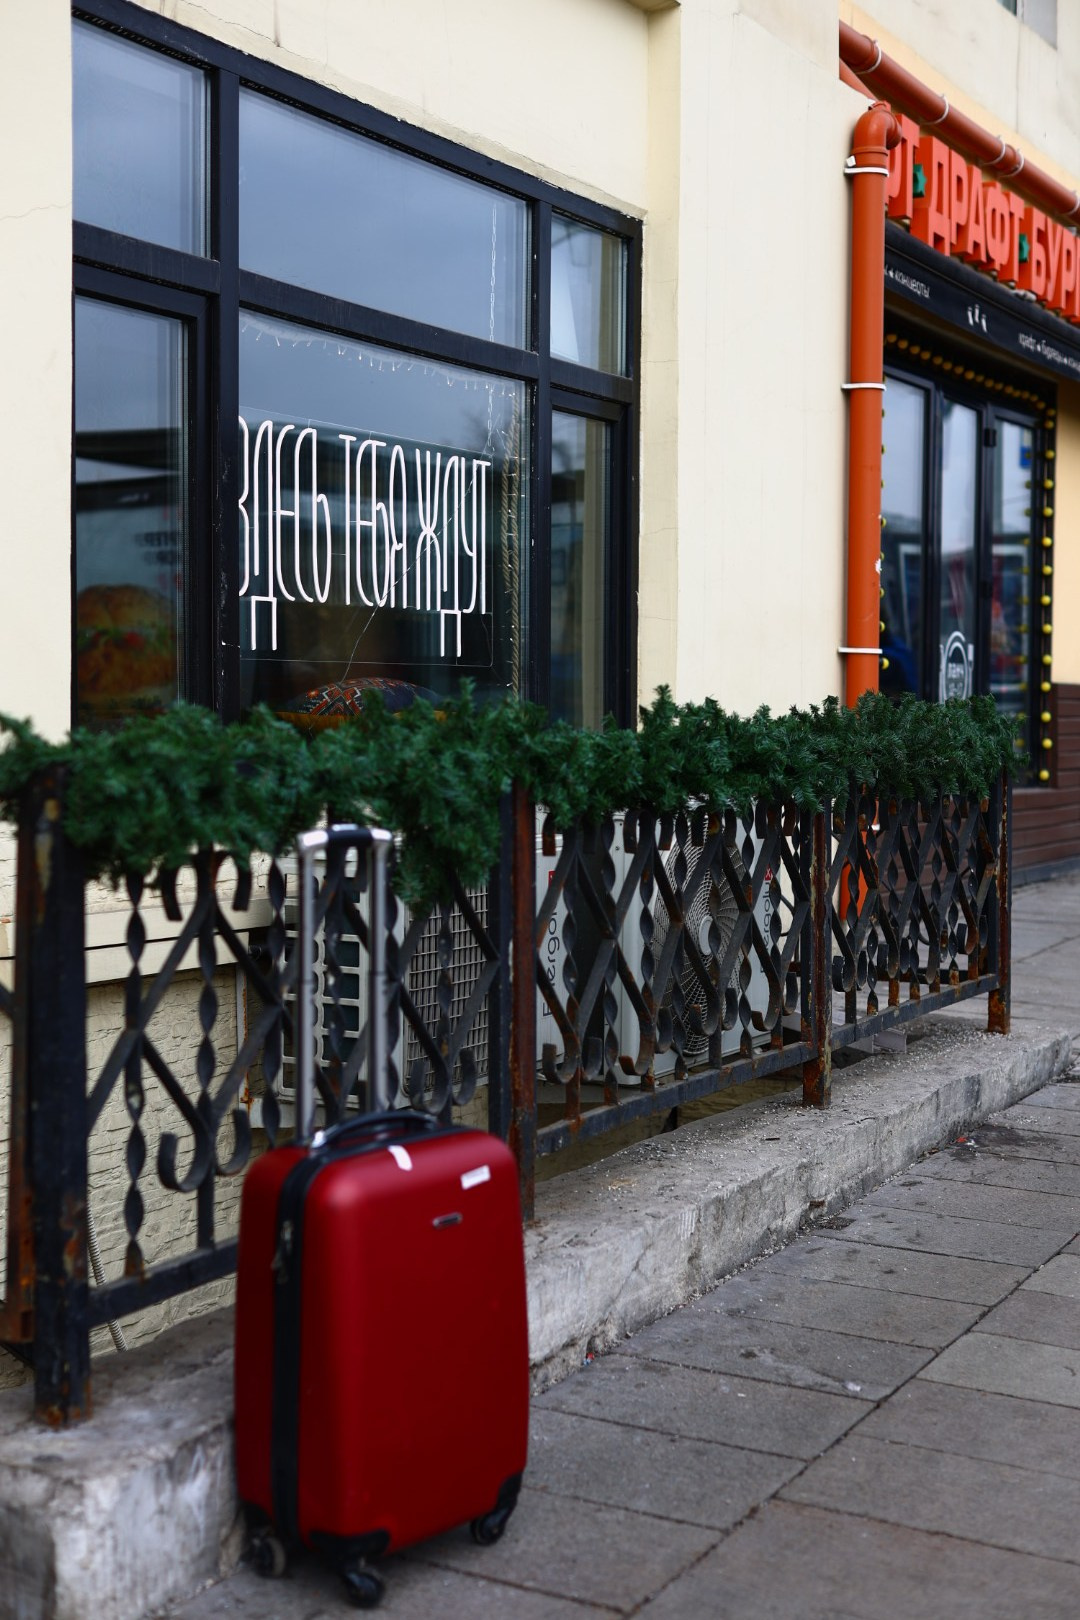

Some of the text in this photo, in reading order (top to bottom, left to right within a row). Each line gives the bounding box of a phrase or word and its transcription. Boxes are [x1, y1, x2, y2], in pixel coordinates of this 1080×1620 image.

[918, 136, 1025, 283] ДРАФТ
[338, 433, 408, 609] ТЕБЯ
[415, 448, 492, 658] ЖДУТ
